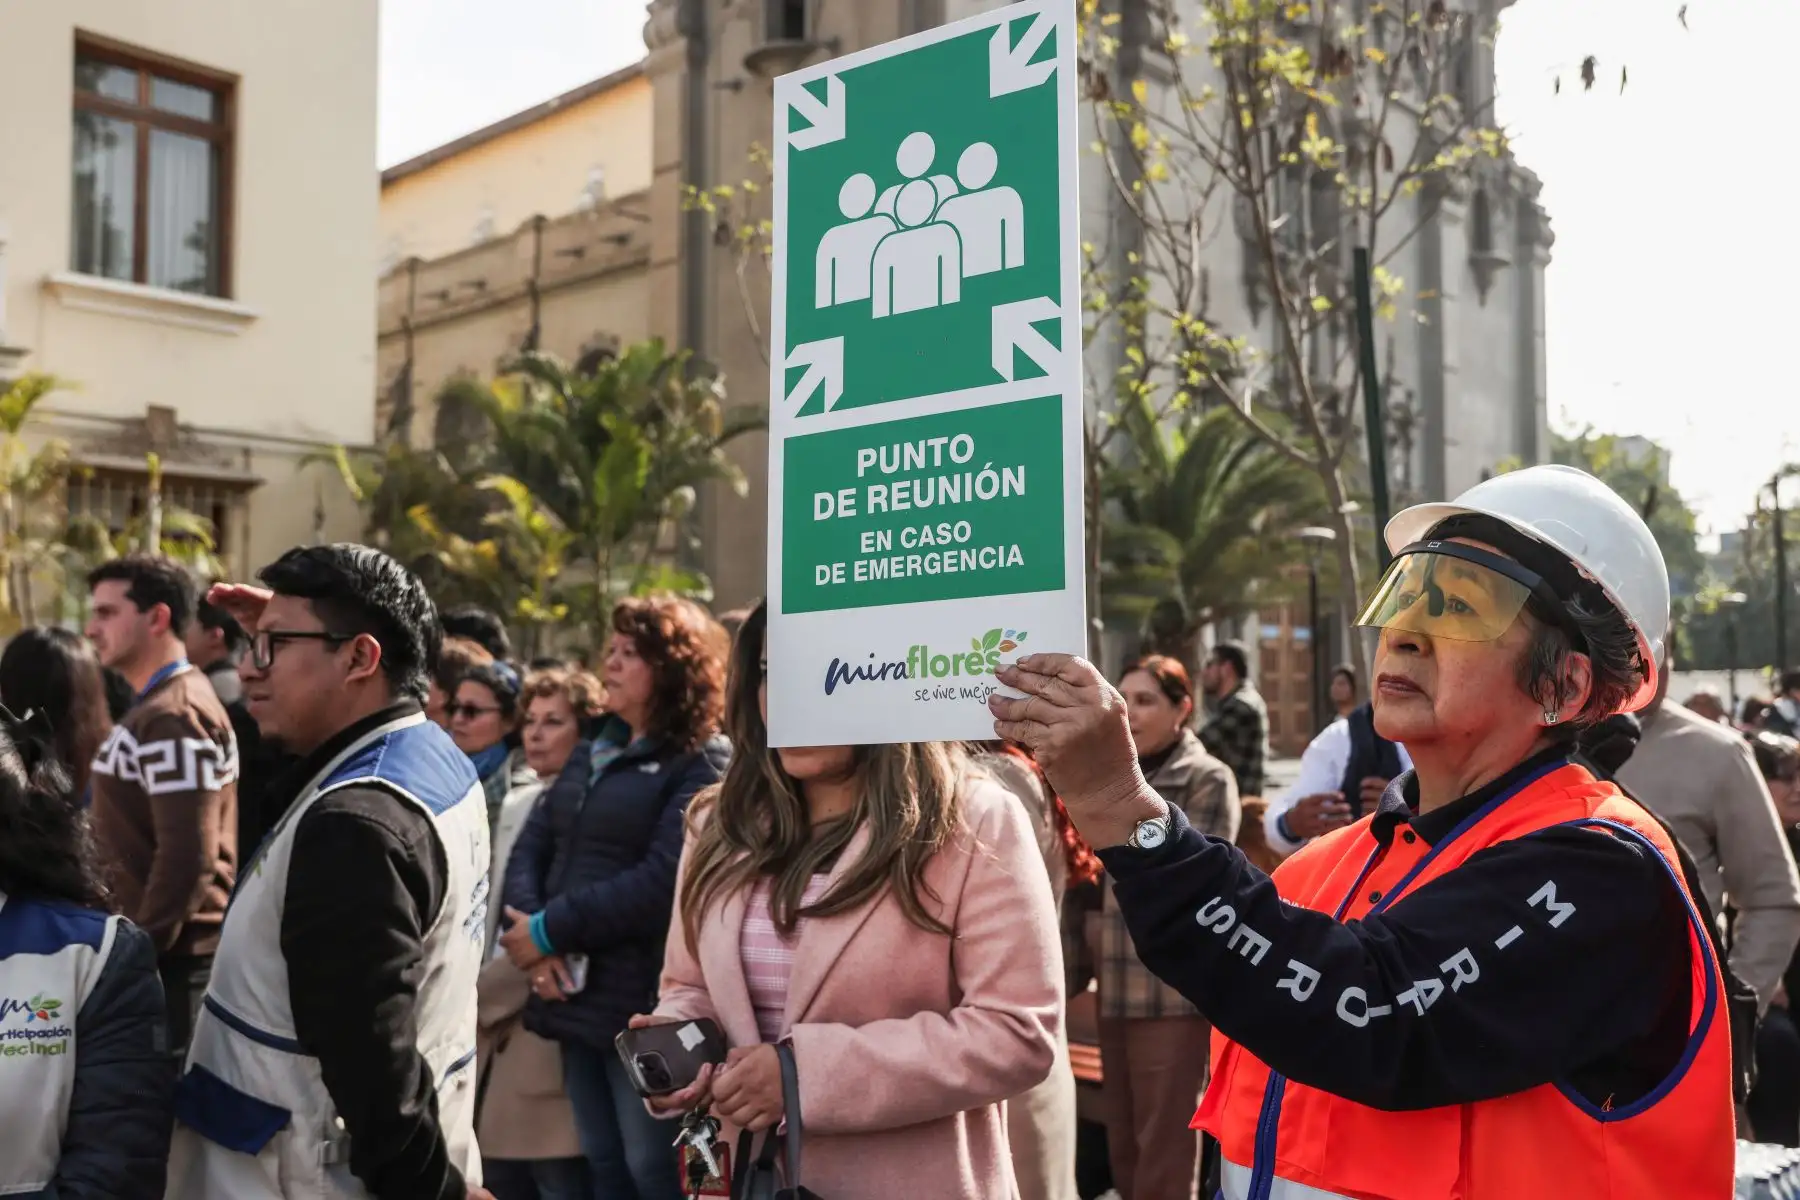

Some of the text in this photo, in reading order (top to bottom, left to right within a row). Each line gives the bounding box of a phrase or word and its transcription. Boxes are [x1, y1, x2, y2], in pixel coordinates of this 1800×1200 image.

[856, 433, 975, 478] PUNTO
[812, 459, 1026, 521] DE REUNIÓN
[860, 520, 972, 553] EN CASO
[814, 544, 1025, 586] DE EMERGENCIA
[824, 644, 1001, 696] miraflores
[914, 682, 998, 705] se vive mejor
